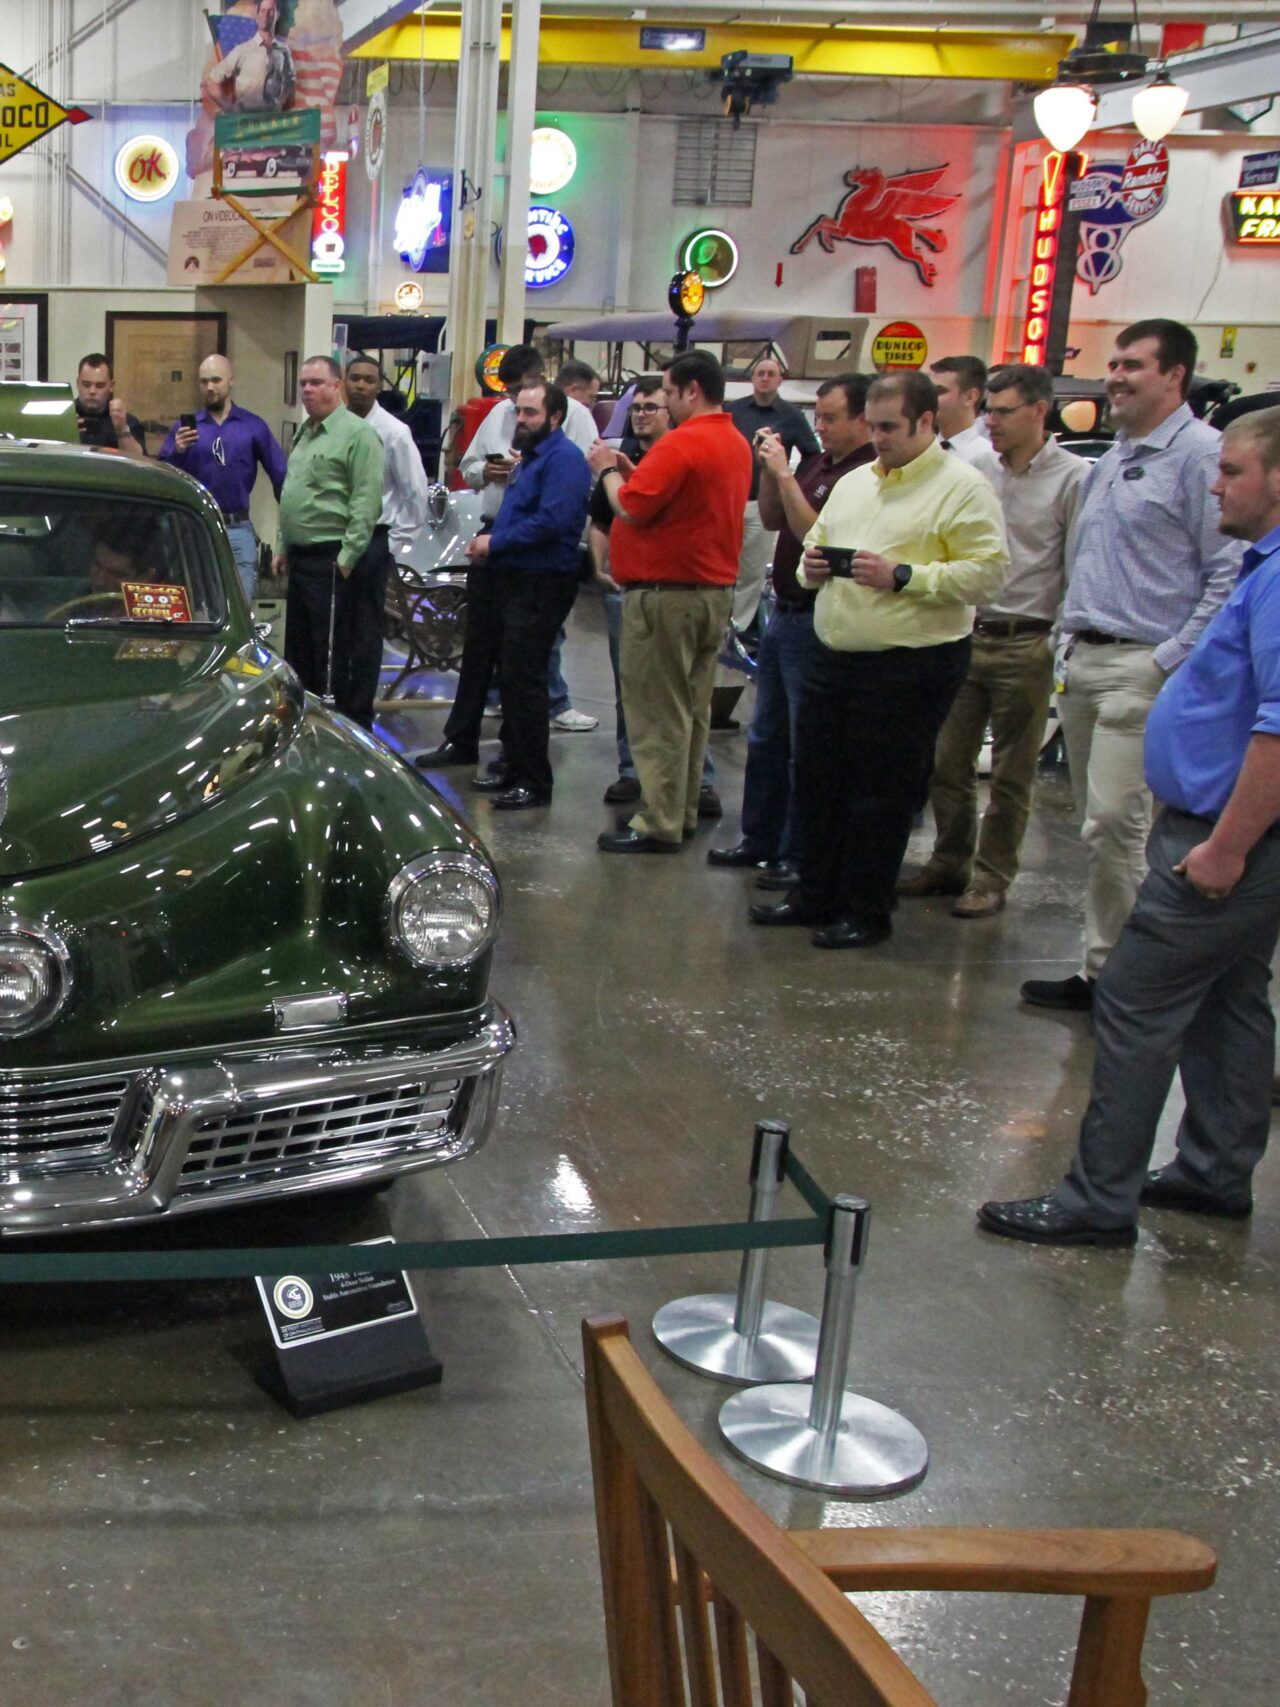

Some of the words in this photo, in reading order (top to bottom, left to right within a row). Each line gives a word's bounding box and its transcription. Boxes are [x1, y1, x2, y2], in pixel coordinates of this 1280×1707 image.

[1133, 140, 1164, 159] PARTS
[129, 147, 168, 183] OK
[1123, 167, 1167, 188] Rambler
[1126, 191, 1160, 216] SERVICE
[203, 211, 215, 223] ON
[1024, 207, 1057, 366] HUDSON
[876, 341, 925, 351] DUNLOP
[884, 352, 914, 361] TIRES
[132, 607, 170, 618] TOUCH
[339, 1286, 368, 1297] Automotive
[368, 1278, 396, 1290] Foundation
[340, 1280, 358, 1288] 4-Door
[358, 1276, 375, 1285] Sedan
